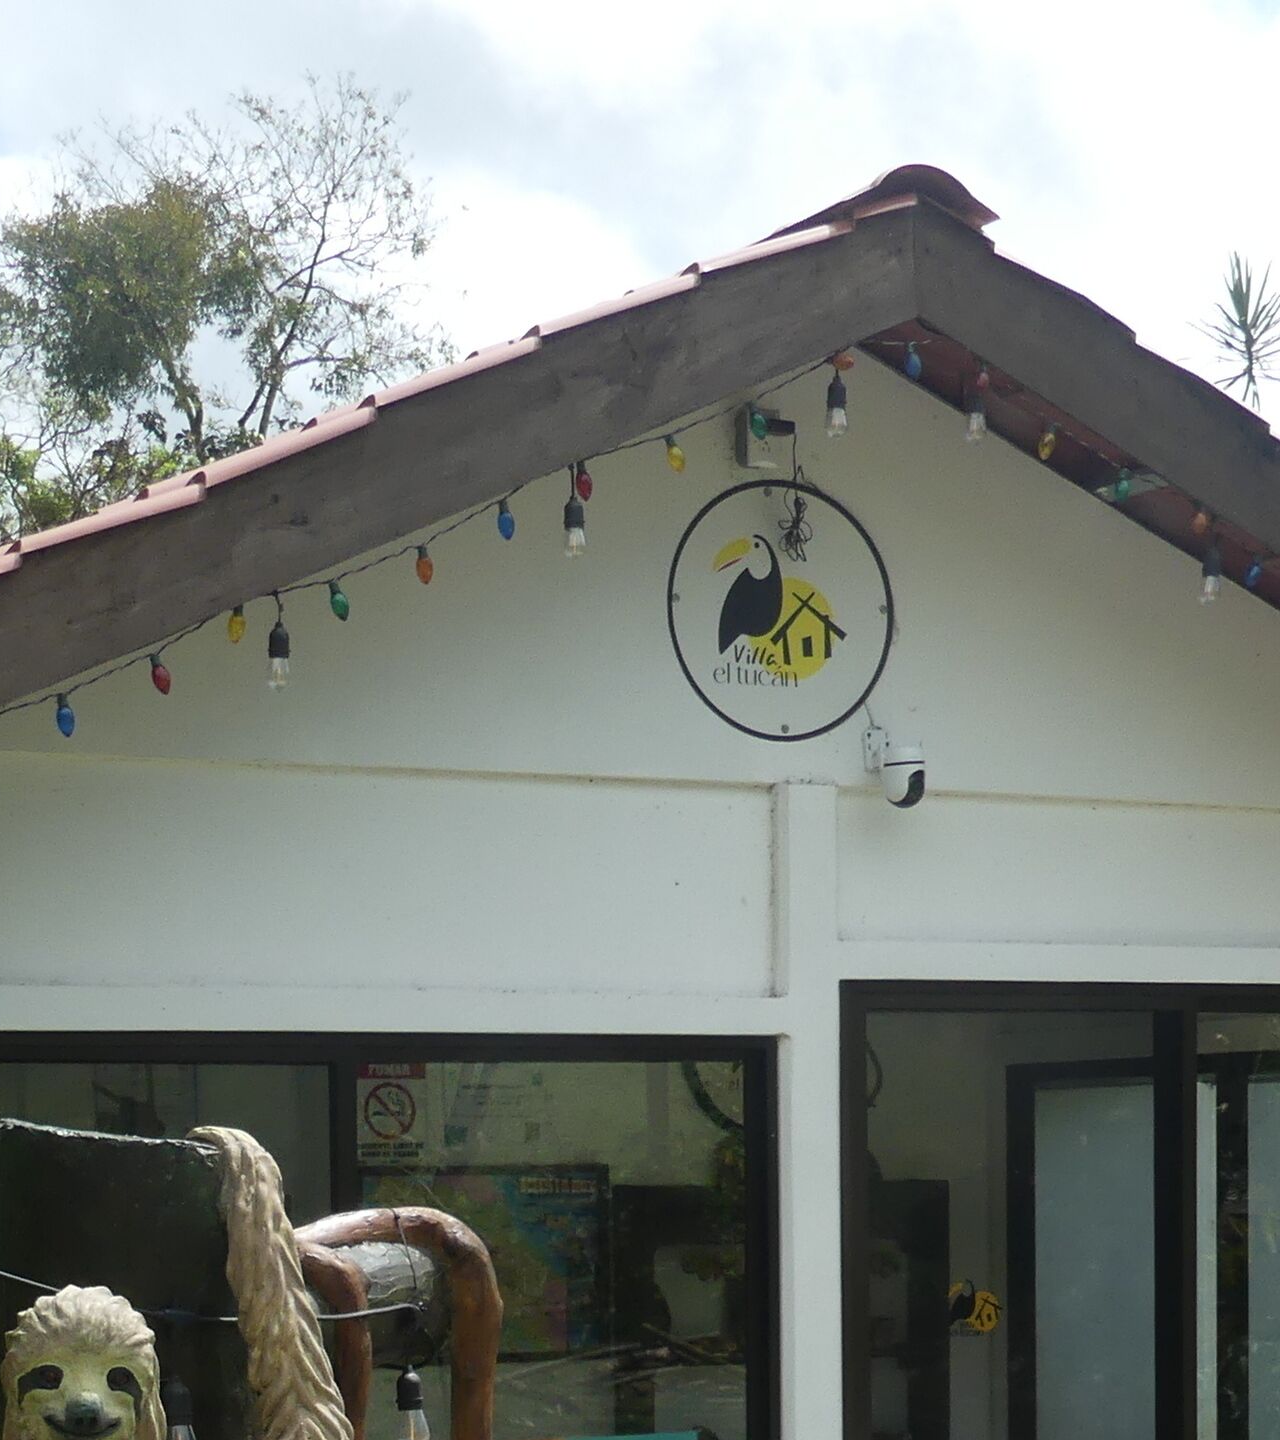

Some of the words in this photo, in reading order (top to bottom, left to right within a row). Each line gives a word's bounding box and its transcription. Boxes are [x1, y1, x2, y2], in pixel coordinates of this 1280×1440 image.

[733, 644, 776, 667] Villa
[712, 663, 731, 685] el
[736, 664, 798, 687] tucán
